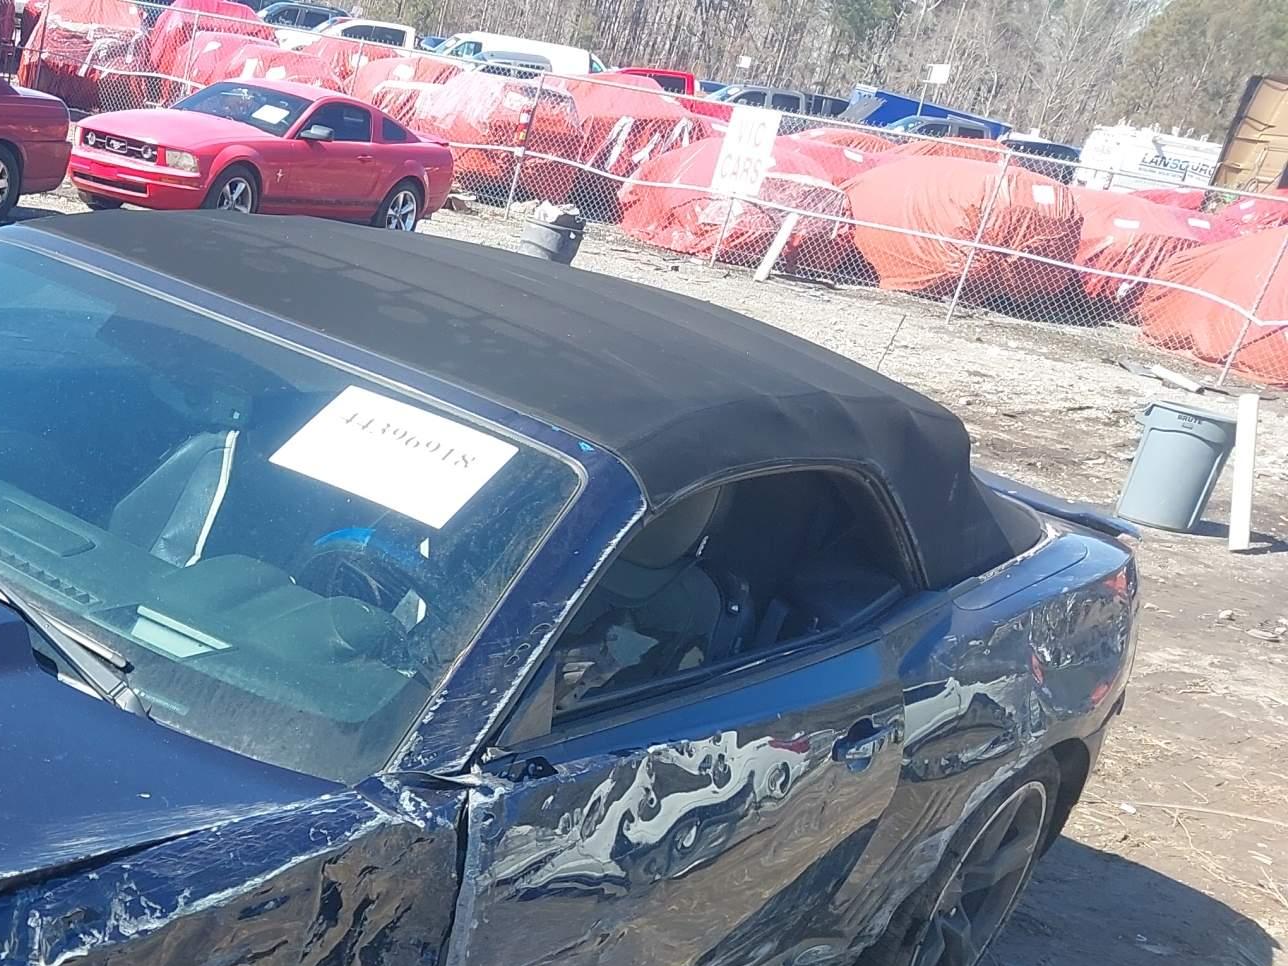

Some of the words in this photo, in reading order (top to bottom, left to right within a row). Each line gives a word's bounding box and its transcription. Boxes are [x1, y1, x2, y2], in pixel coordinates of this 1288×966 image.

[720, 153, 762, 184] CARS
[1177, 414, 1203, 425] BRUTE
[339, 413, 477, 471] 44396918
